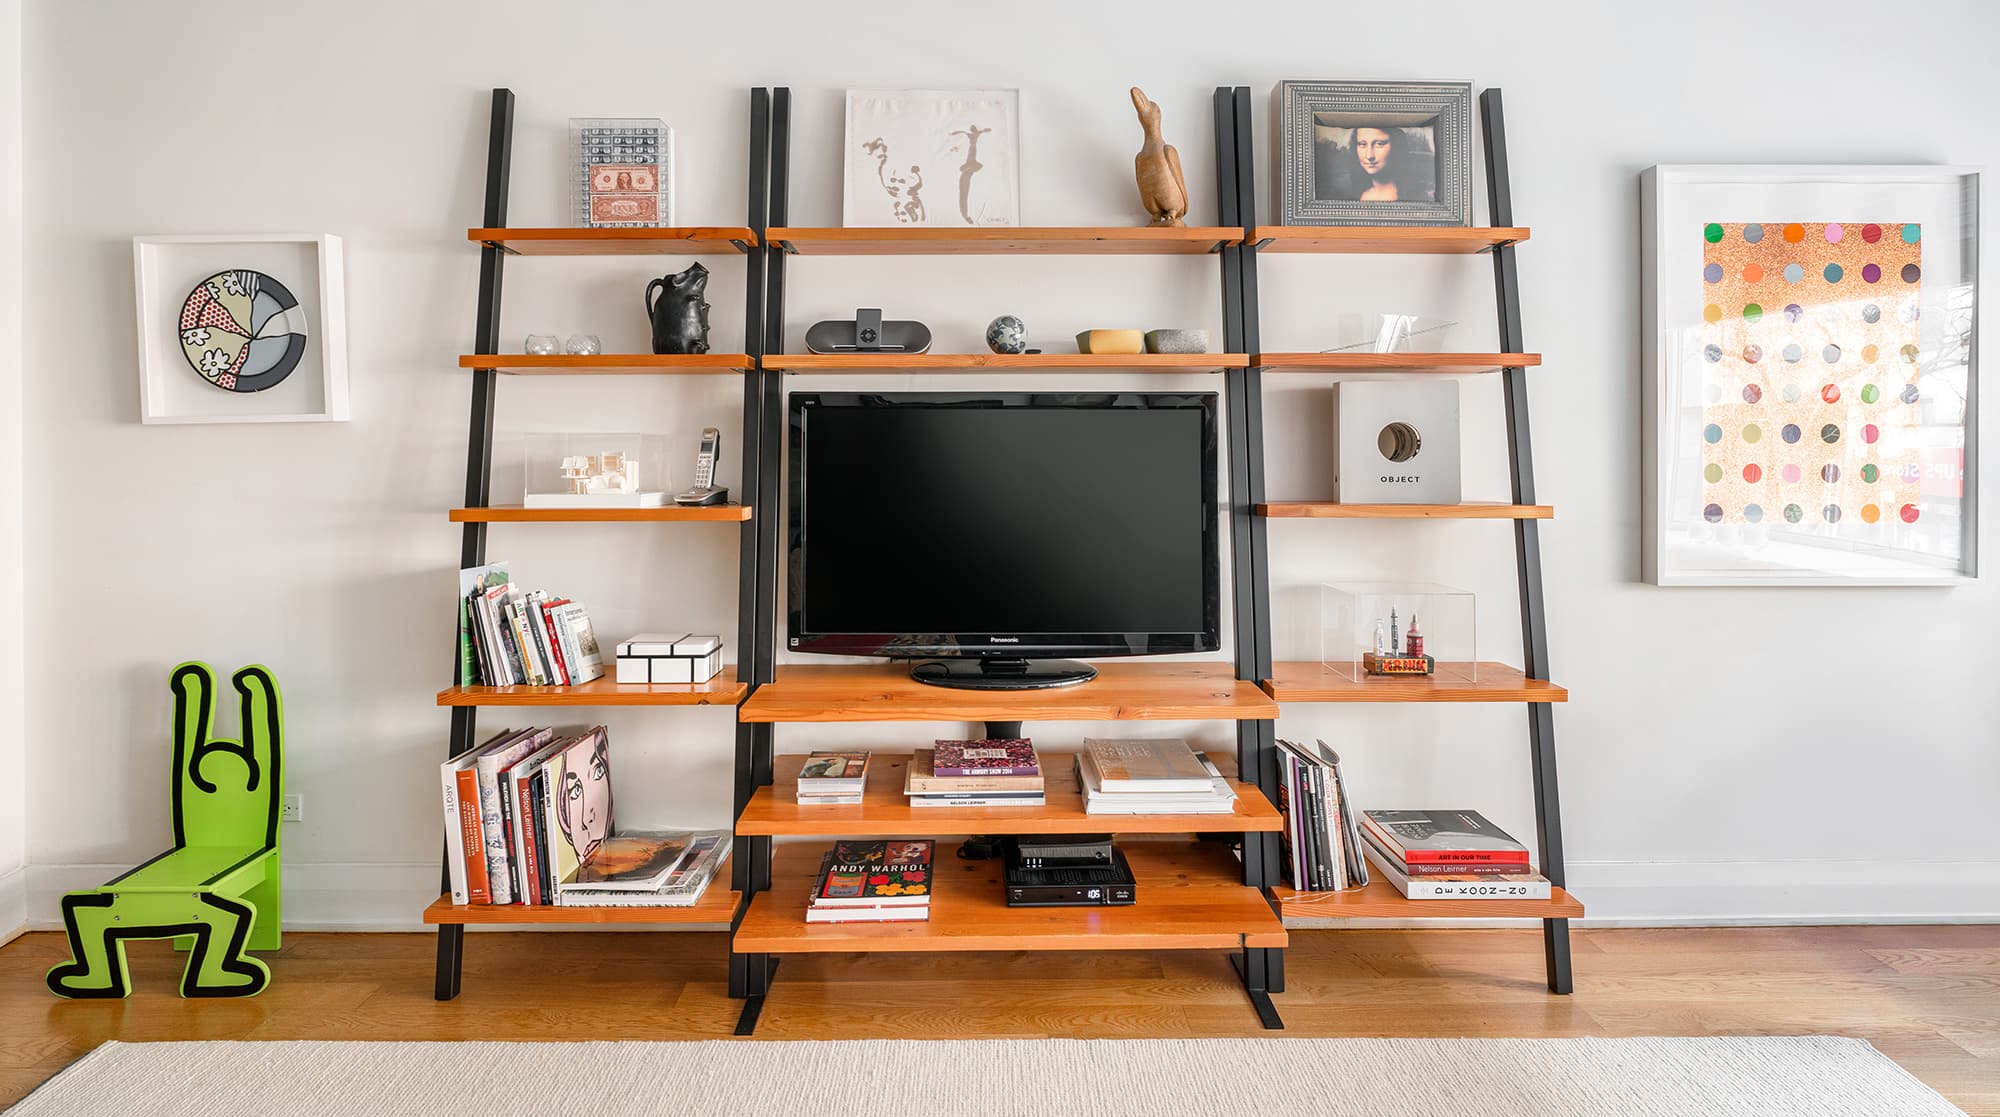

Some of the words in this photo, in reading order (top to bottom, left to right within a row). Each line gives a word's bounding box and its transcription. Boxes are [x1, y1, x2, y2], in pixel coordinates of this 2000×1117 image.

[990, 635, 1019, 643] Panasonic
[522, 788, 530, 813] Nelson
[524, 814, 532, 838] Leirner
[830, 864, 865, 873] ANDY
[871, 864, 925, 873] WARHOL
[1418, 864, 1441, 873] Nelson
[1442, 864, 1467, 873] Leirner
[1435, 887, 1453, 895] DE
[1459, 886, 1527, 895] KOONING
